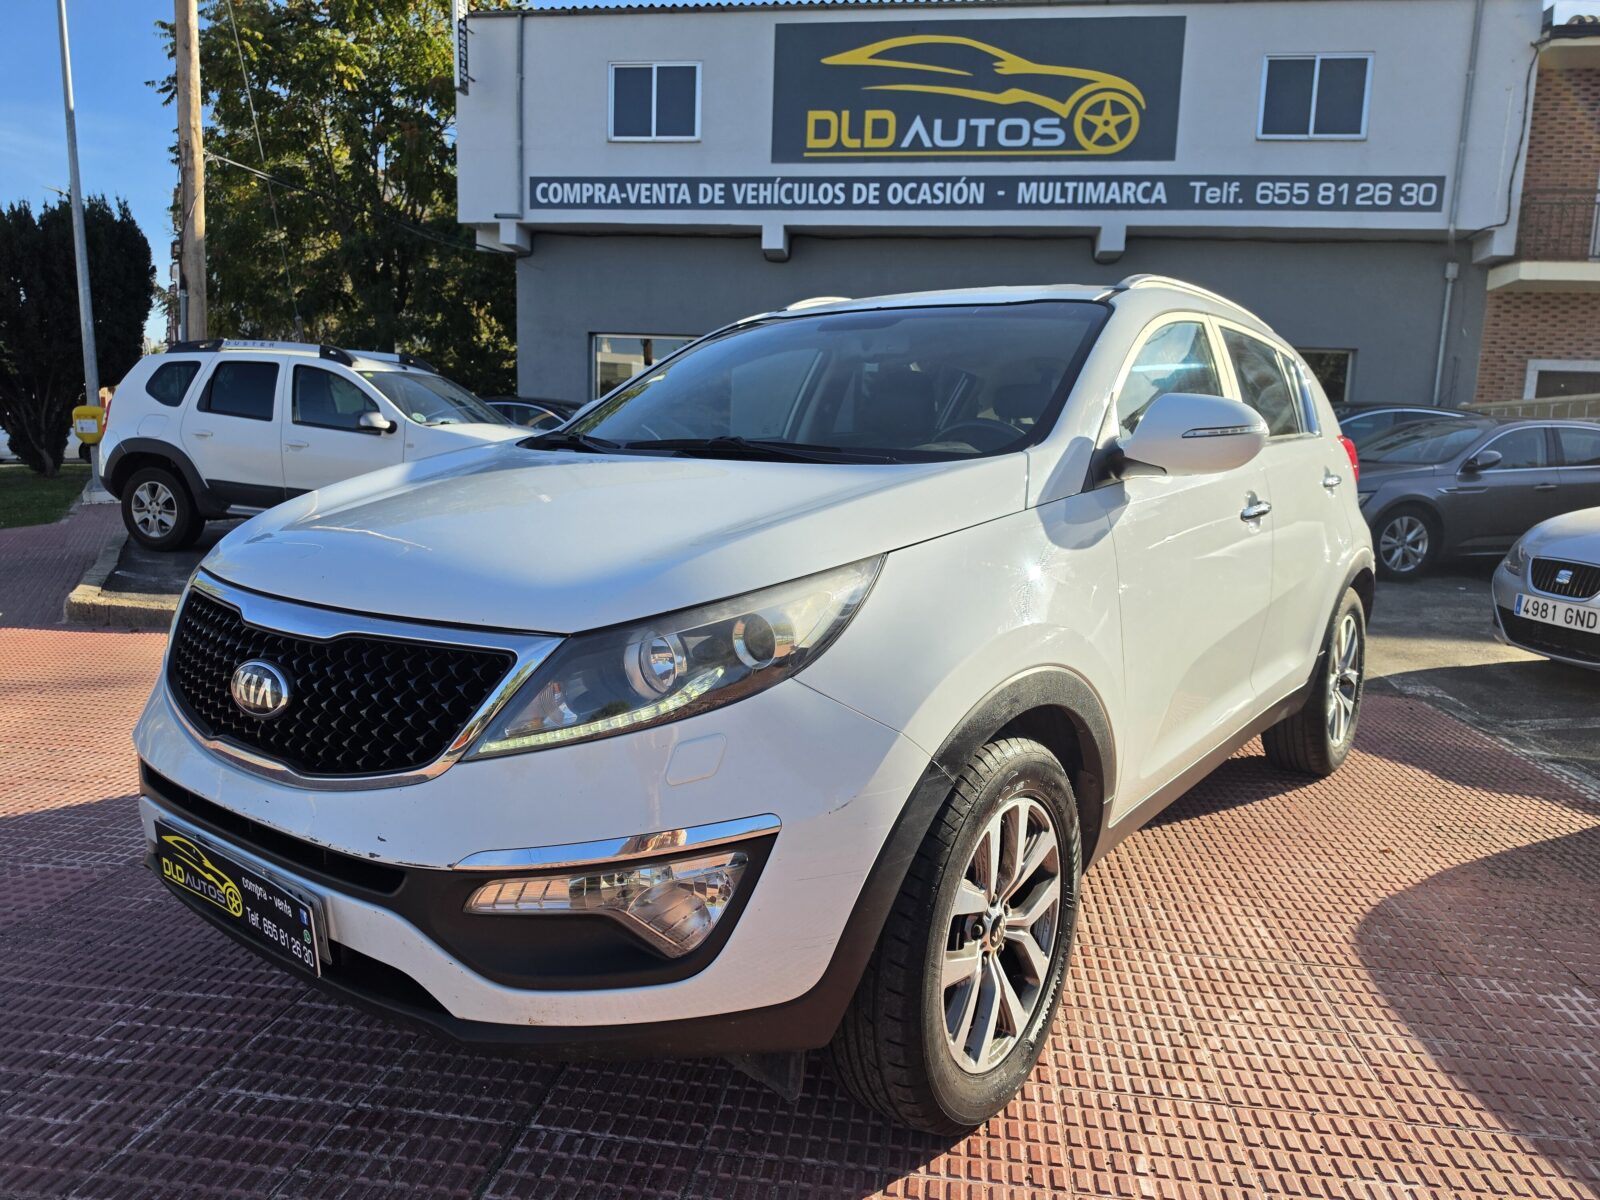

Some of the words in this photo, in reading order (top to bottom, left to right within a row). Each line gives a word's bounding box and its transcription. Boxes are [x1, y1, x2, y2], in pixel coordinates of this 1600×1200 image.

[806, 110, 896, 148] DLD
[901, 114, 1066, 147] AUTOS
[535, 182, 692, 205] COMPRA-VENTA
[698, 183, 725, 204] DE
[732, 177, 845, 205] VEHÍCULOS
[852, 182, 880, 205] DE
[887, 176, 985, 205] OCASIÓN
[1017, 181, 1167, 205] MULTIMARCA
[1189, 181, 1243, 204] Telf.
[1256, 182, 1310, 205] 655
[1400, 182, 1438, 206] 30
[1523, 598, 1557, 621] 4981
[1564, 607, 1598, 629] GND
[236, 670, 273, 709] KIA
[162, 857, 185, 883] DLD
[185, 872, 226, 904] AUTOS
[242, 877, 267, 900] compra
[274, 895, 293, 918] venta
[246, 906, 261, 930] Telf.
[262, 917, 278, 941] 655
[280, 928, 290, 949] 81
[291, 936, 302, 958] 26
[302, 945, 314, 968] 30
